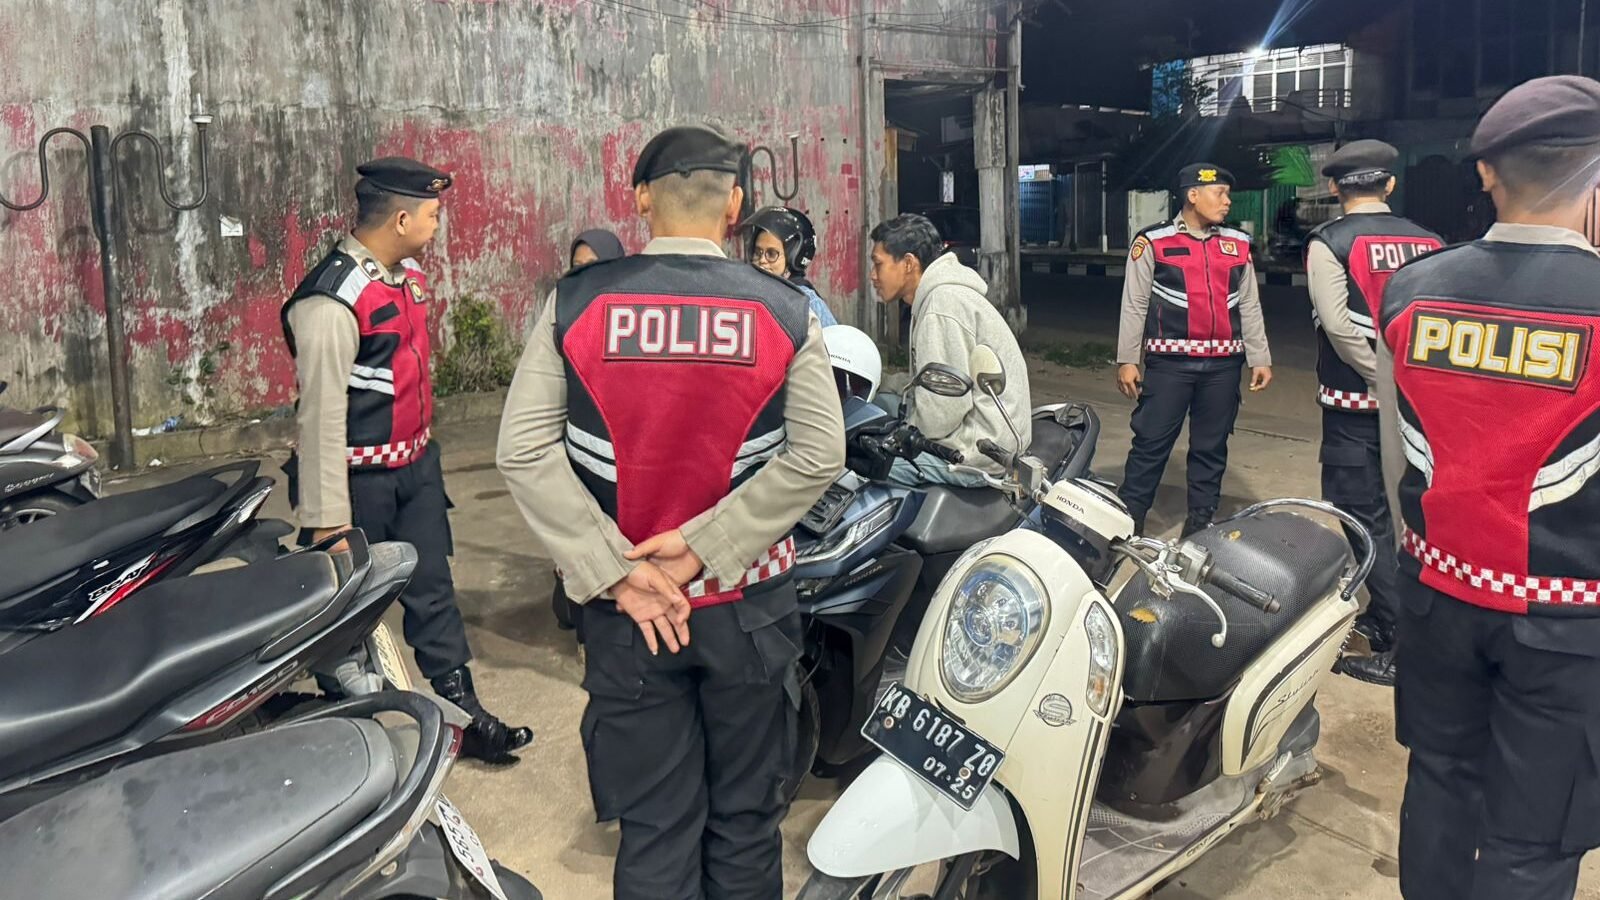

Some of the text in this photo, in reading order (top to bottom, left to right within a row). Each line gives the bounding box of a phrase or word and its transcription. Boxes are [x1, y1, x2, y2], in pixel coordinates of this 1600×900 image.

[1370, 243, 1432, 270] POLI
[608, 306, 753, 358] POLISI
[1413, 315, 1580, 382] POLISI
[1056, 495, 1084, 514] HONDA
[881, 687, 911, 718] KB
[912, 708, 965, 753] 6187
